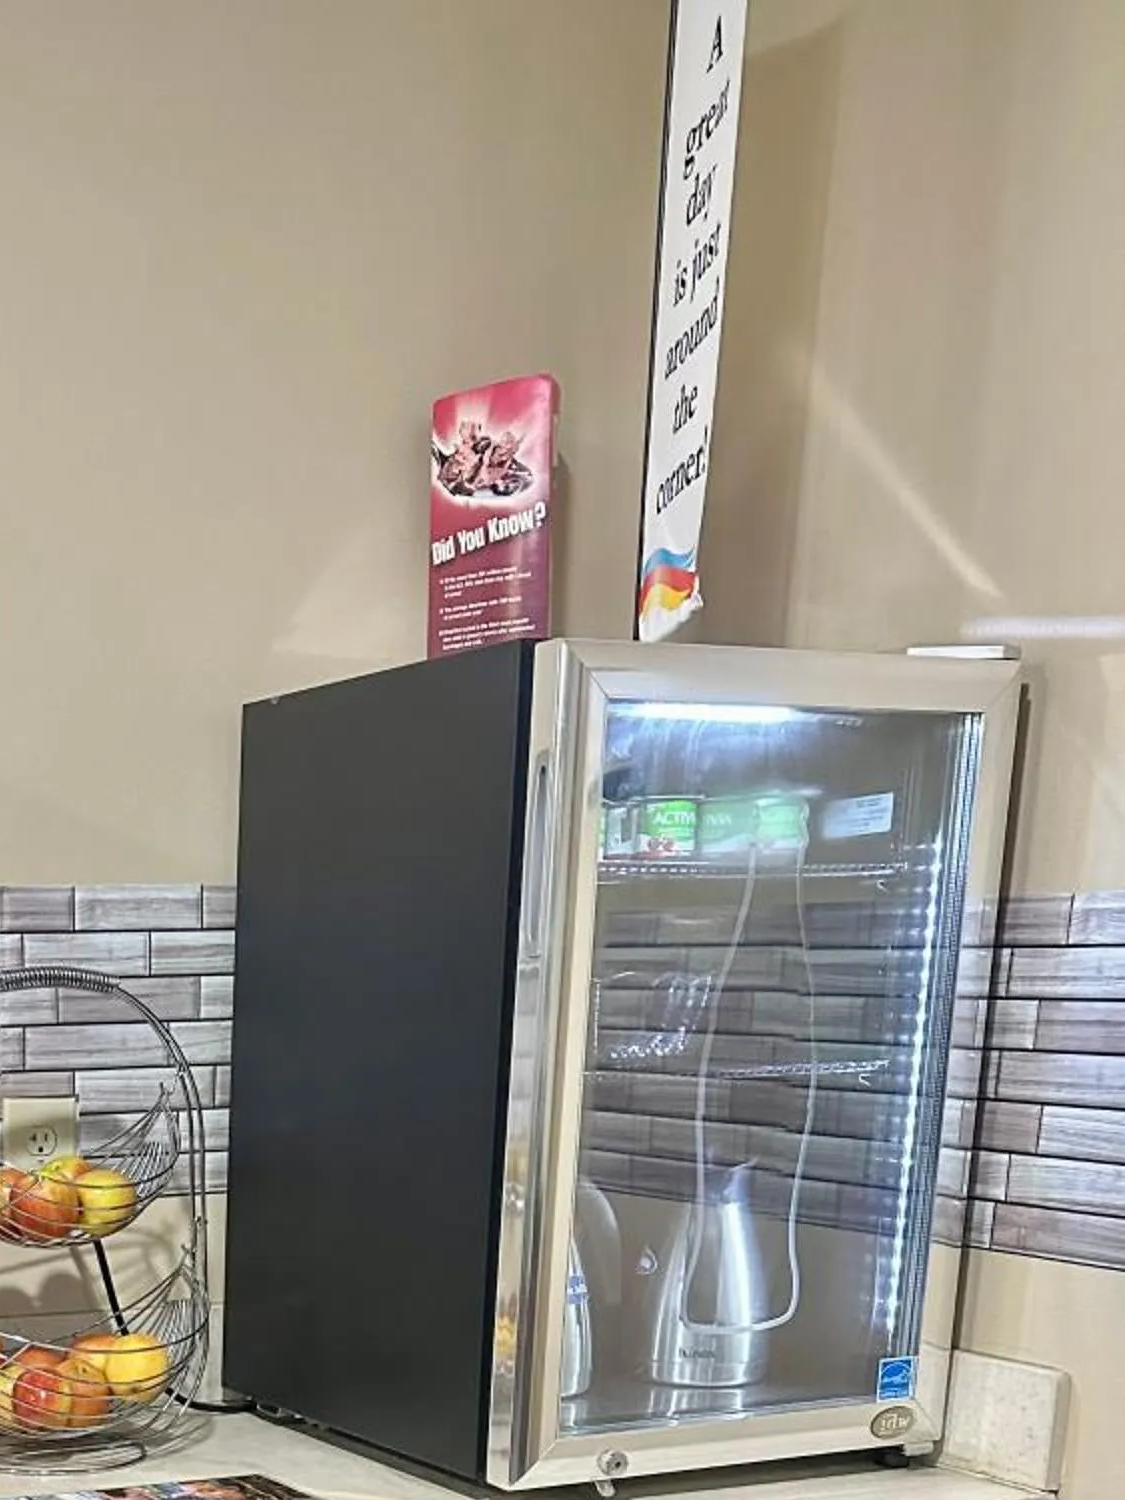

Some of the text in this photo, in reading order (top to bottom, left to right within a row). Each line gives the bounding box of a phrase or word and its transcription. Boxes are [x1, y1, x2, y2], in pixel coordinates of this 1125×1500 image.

[706, 15, 723, 73] A
[686, 164, 717, 226] day
[673, 222, 721, 307] is just
[665, 275, 719, 380] around
[673, 384, 698, 434] the
[432, 501, 546, 565] Did You Know?
